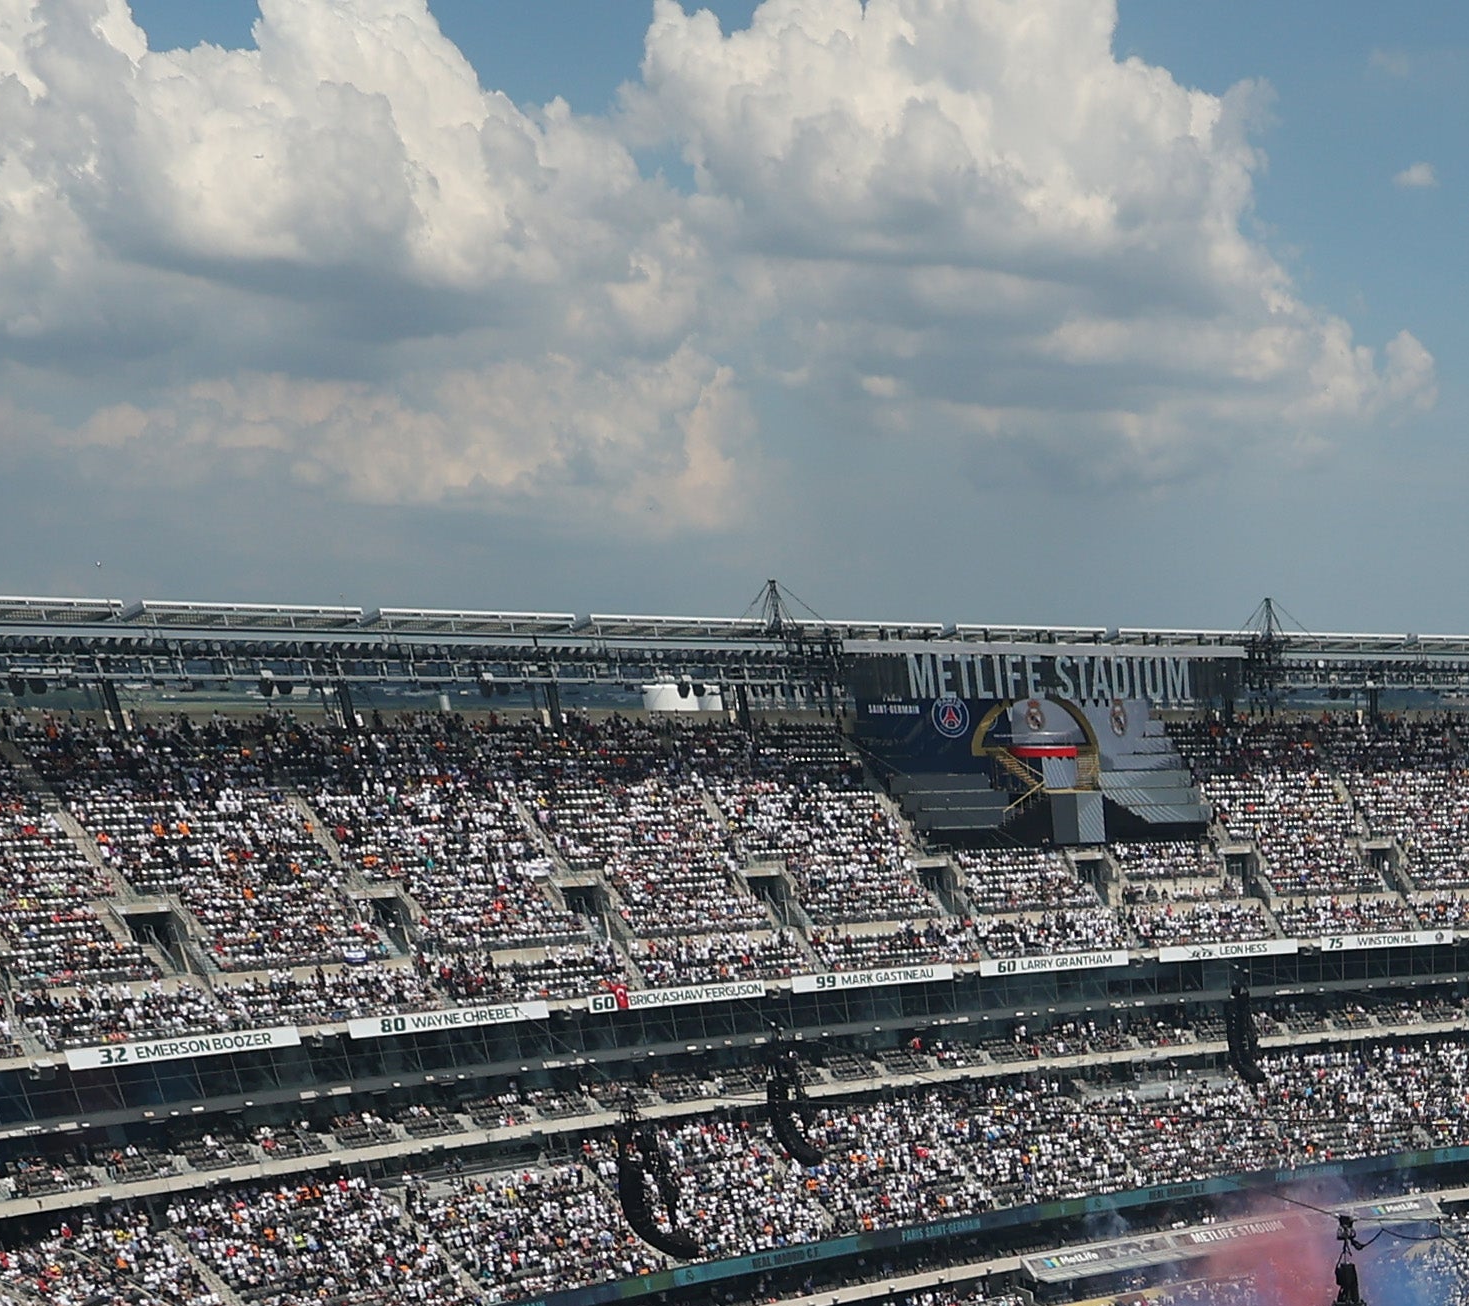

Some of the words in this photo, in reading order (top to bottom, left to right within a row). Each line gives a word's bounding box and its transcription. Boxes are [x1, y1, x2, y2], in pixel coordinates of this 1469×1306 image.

[906, 654, 1046, 700] METLIFE
[1055, 656, 1191, 700] STADIUM
[1220, 945, 1244, 955] LEON
[1245, 943, 1268, 954] HESS
[1330, 937, 1343, 948] 75
[1357, 935, 1400, 946] WINSTON
[1401, 933, 1418, 944] HILL
[998, 960, 1016, 973] 60
[1021, 957, 1054, 970] LARRY
[1056, 954, 1113, 968] GRANTHAM
[816, 975, 836, 988] 99
[841, 973, 874, 985] MARK
[876, 969, 934, 982] GASTINEAU
[592, 996, 614, 1011] 60
[705, 983, 762, 1000] FERGUSON
[381, 1017, 406, 1032] 80
[411, 1013, 461, 1028] WAYNE
[463, 1007, 520, 1022] CHREBET
[100, 1047, 128, 1064] 32
[136, 1040, 210, 1059] EMERSON
[213, 1032, 272, 1050] BOOZER
[1190, 1228, 1239, 1245] METLIFE
[1059, 1251, 1099, 1265] MetLife
